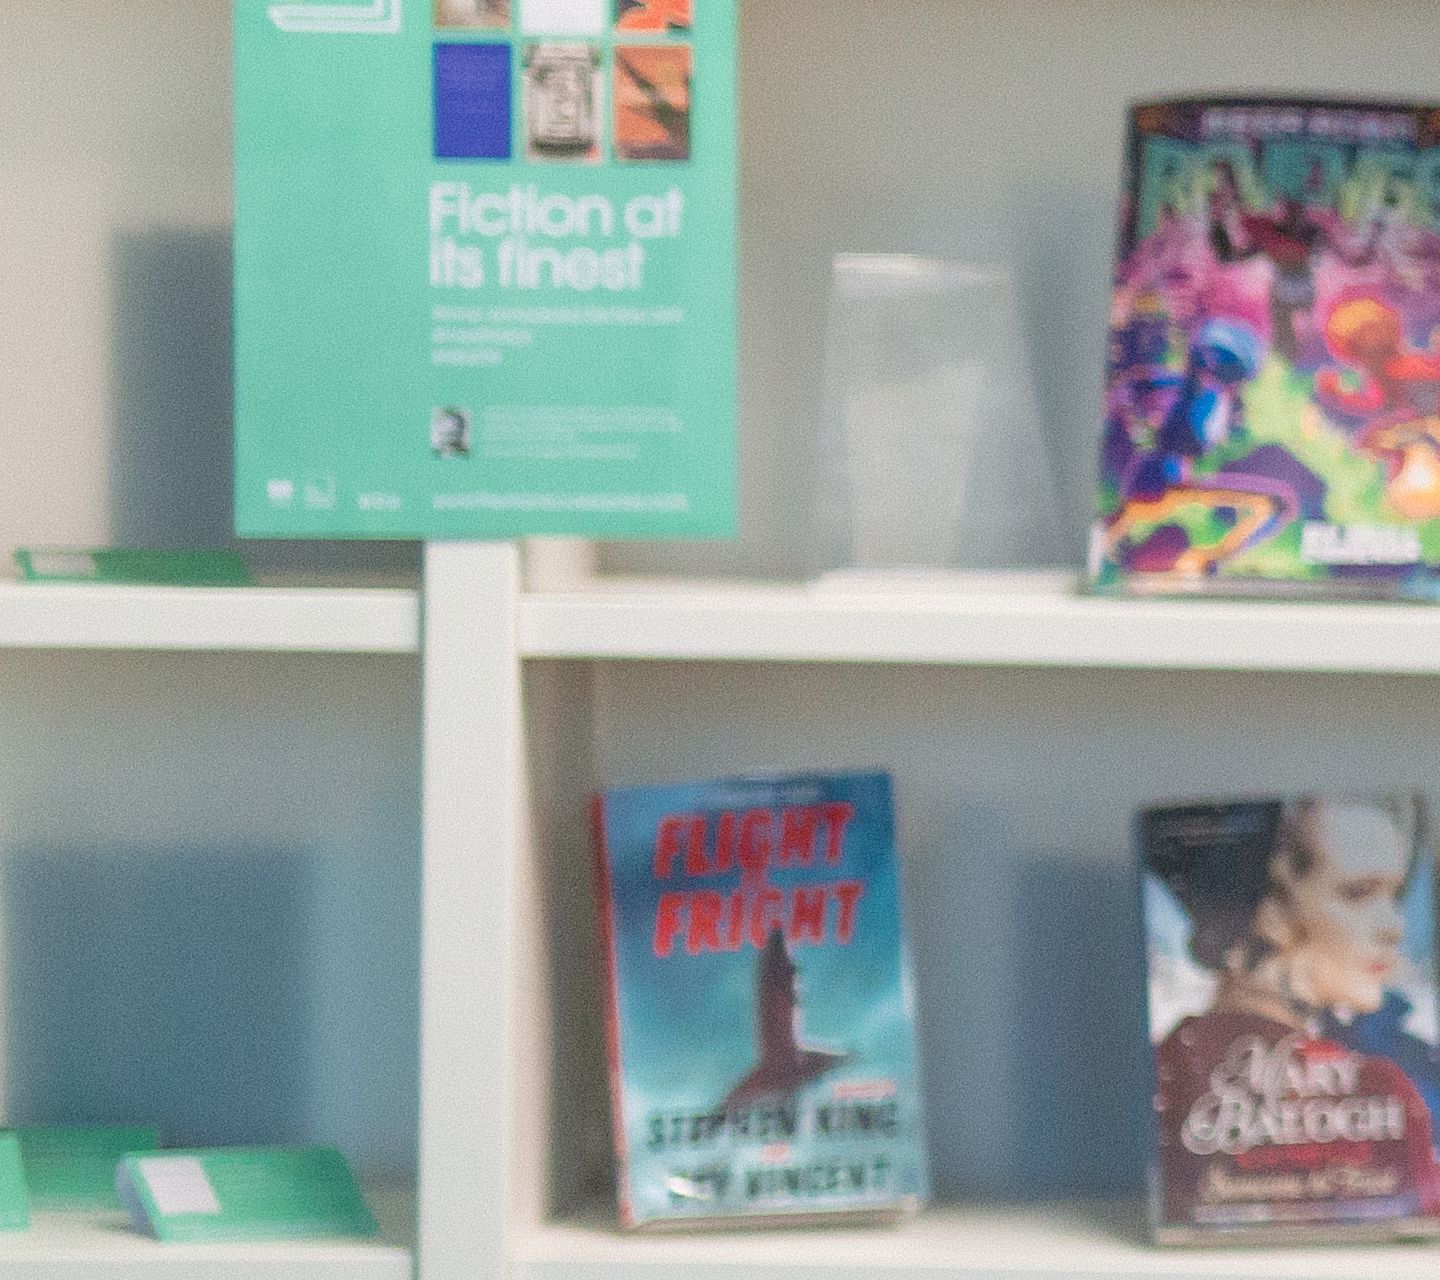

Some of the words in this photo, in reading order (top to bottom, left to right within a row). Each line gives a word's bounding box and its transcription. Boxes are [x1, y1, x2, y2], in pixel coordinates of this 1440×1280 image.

[427, 182, 611, 238] Fiction
[623, 186, 684, 238] at
[427, 241, 485, 290] its
[499, 242, 646, 291] finest
[652, 800, 855, 880] FLIGHT
[651, 879, 864, 959] FRIGHT
